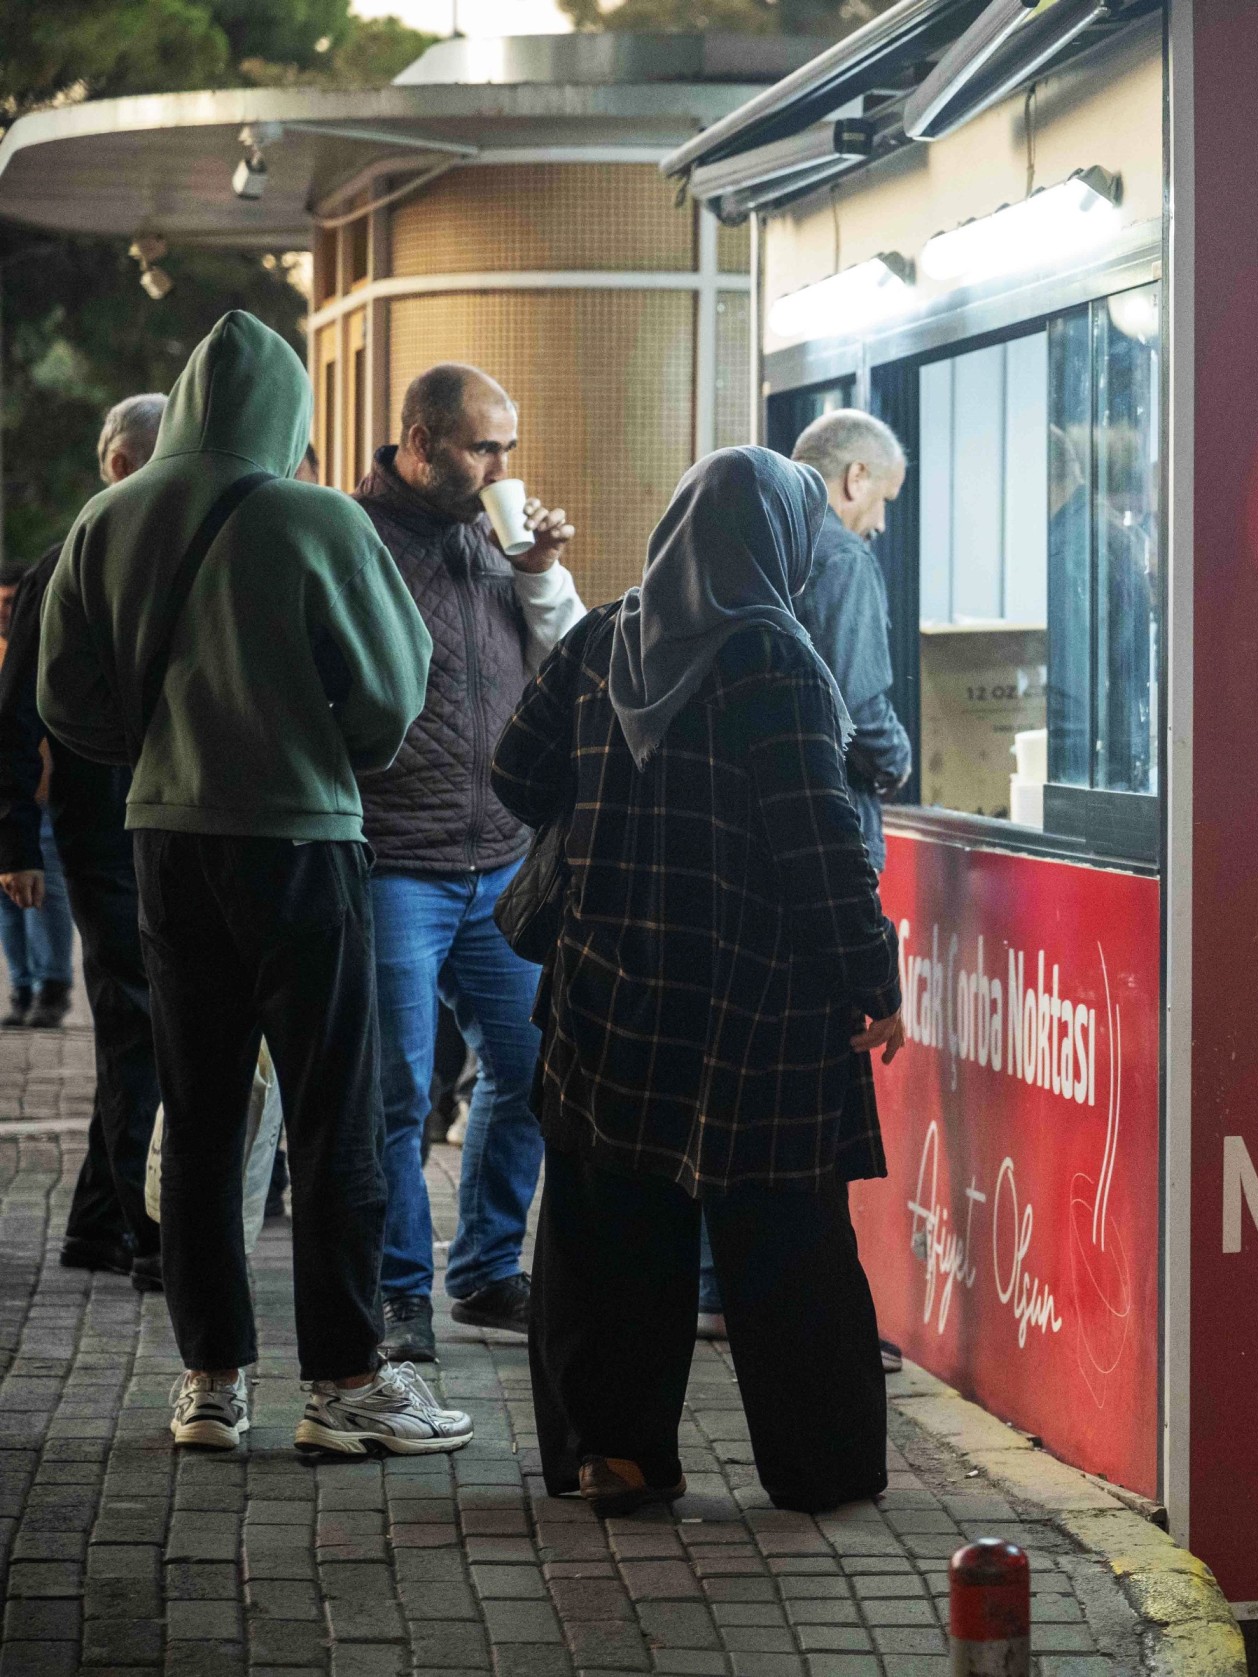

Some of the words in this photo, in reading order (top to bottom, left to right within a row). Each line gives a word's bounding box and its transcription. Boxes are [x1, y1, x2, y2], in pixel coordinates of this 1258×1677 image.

[948, 933, 1002, 1092] Çorba
[1008, 948, 1095, 1106] Noktası
[993, 1157, 1062, 1349] Olsun
